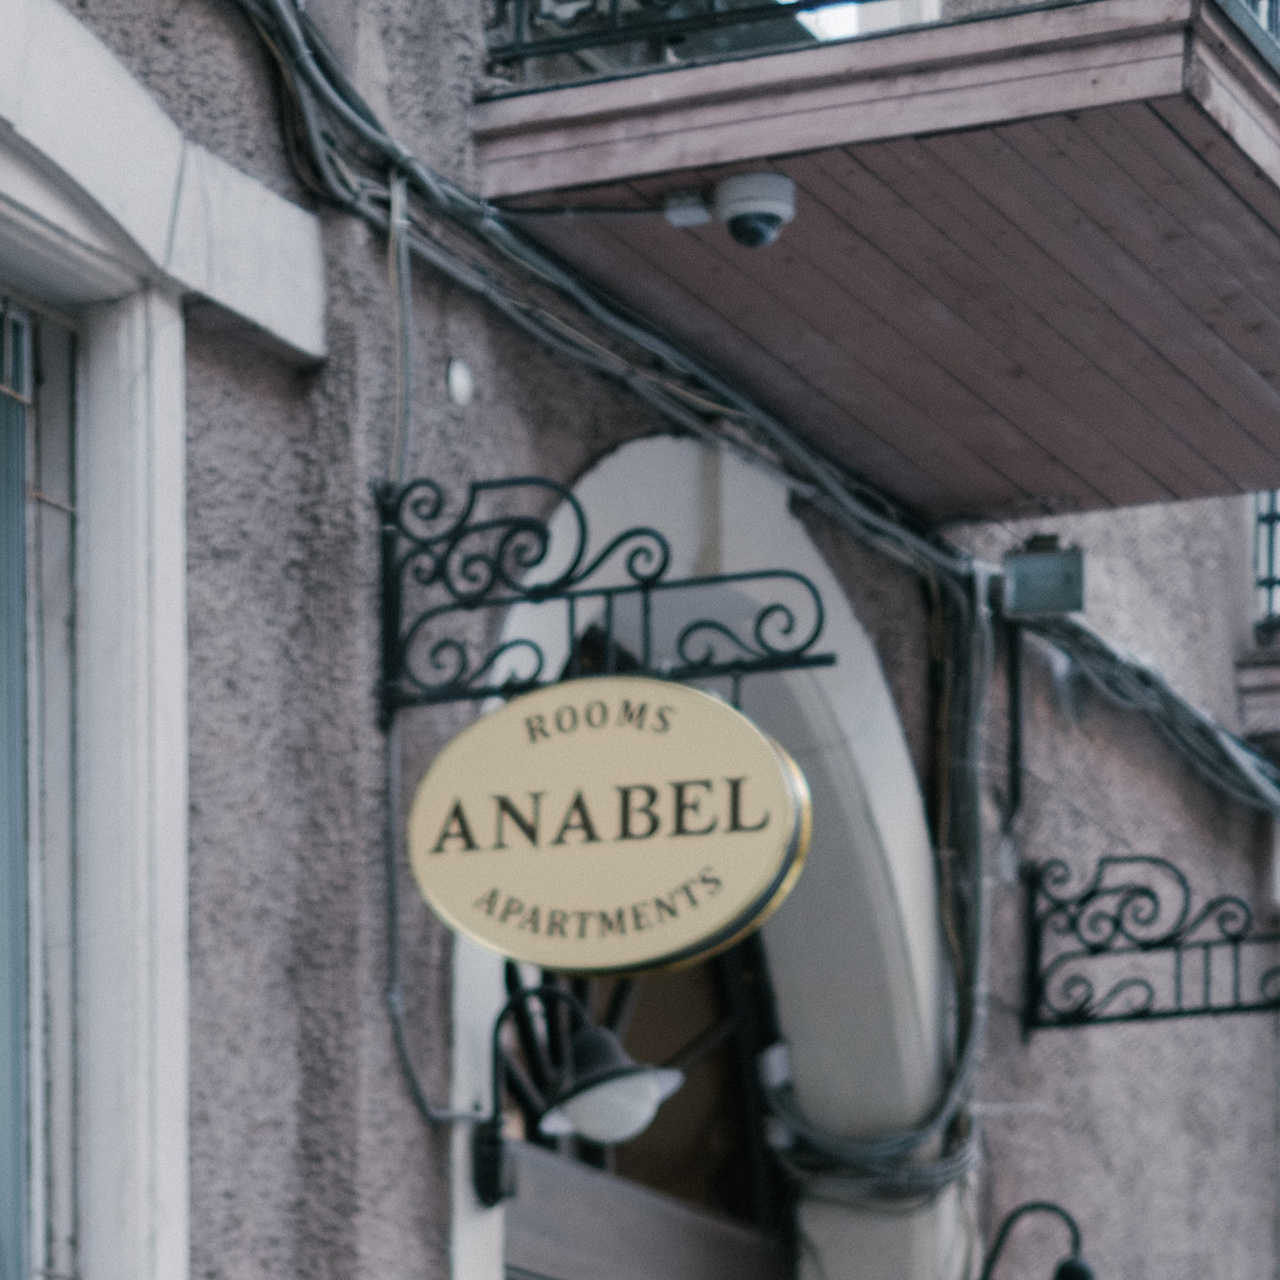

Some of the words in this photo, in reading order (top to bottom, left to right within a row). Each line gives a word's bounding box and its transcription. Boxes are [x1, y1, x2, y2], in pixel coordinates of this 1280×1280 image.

[524, 699, 676, 744] ROOMS
[429, 776, 770, 855] ANABEL
[473, 866, 723, 939] APARTMENTS
